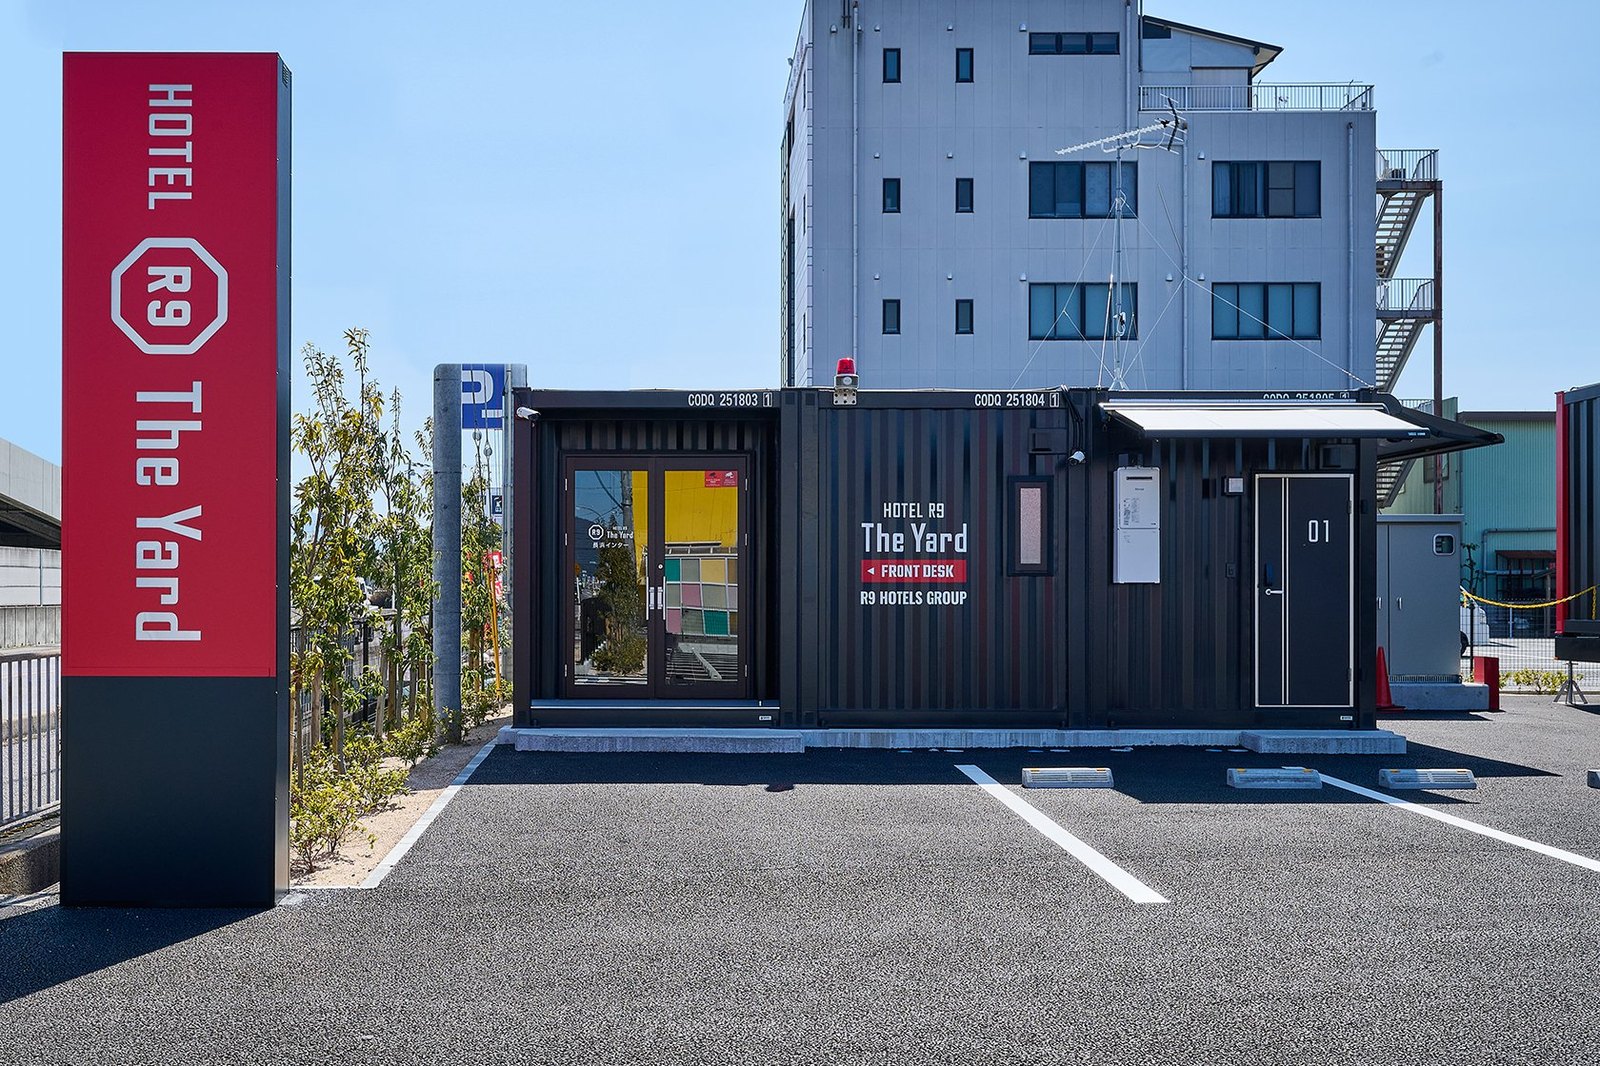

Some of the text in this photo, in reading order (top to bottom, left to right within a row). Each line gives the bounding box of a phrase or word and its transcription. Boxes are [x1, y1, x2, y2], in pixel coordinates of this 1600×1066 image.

[135, 84, 202, 641] HOTEL R9 The Yard
[688, 392, 715, 407] CODQ
[719, 392, 758, 407] 251803
[974, 393, 1002, 407] CODQ
[1006, 393, 1045, 407] 251804
[883, 502, 945, 519] HOTEL R9
[861, 522, 968, 553] The Yard
[1308, 519, 1329, 543] 01
[881, 564, 954, 579] FRONT DESK
[860, 590, 968, 606] R9 HOTELS GROUP
